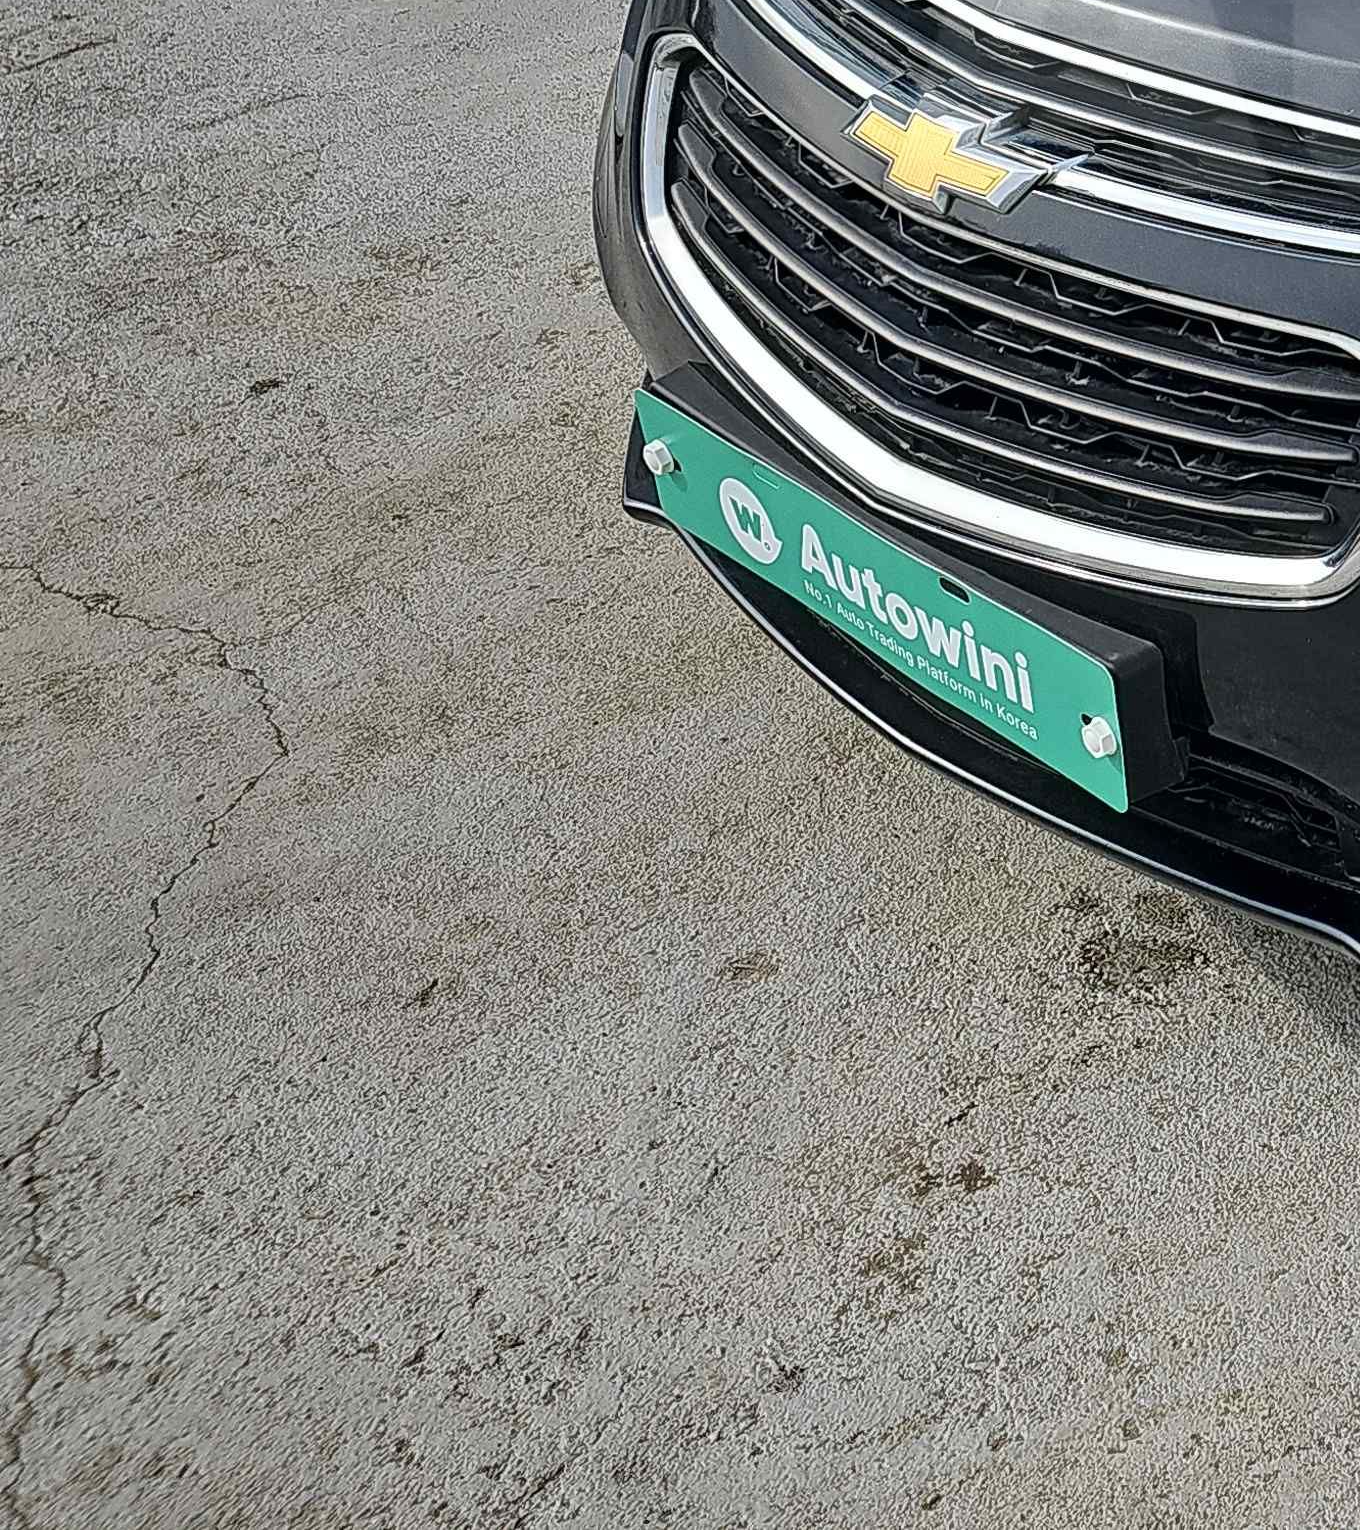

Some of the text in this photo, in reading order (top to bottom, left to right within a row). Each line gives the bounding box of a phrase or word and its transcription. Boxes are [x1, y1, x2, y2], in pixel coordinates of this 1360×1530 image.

[801, 523, 1035, 714] Autowini
[803, 579, 1039, 741] No.1 Auto Trading Platform in Korea
